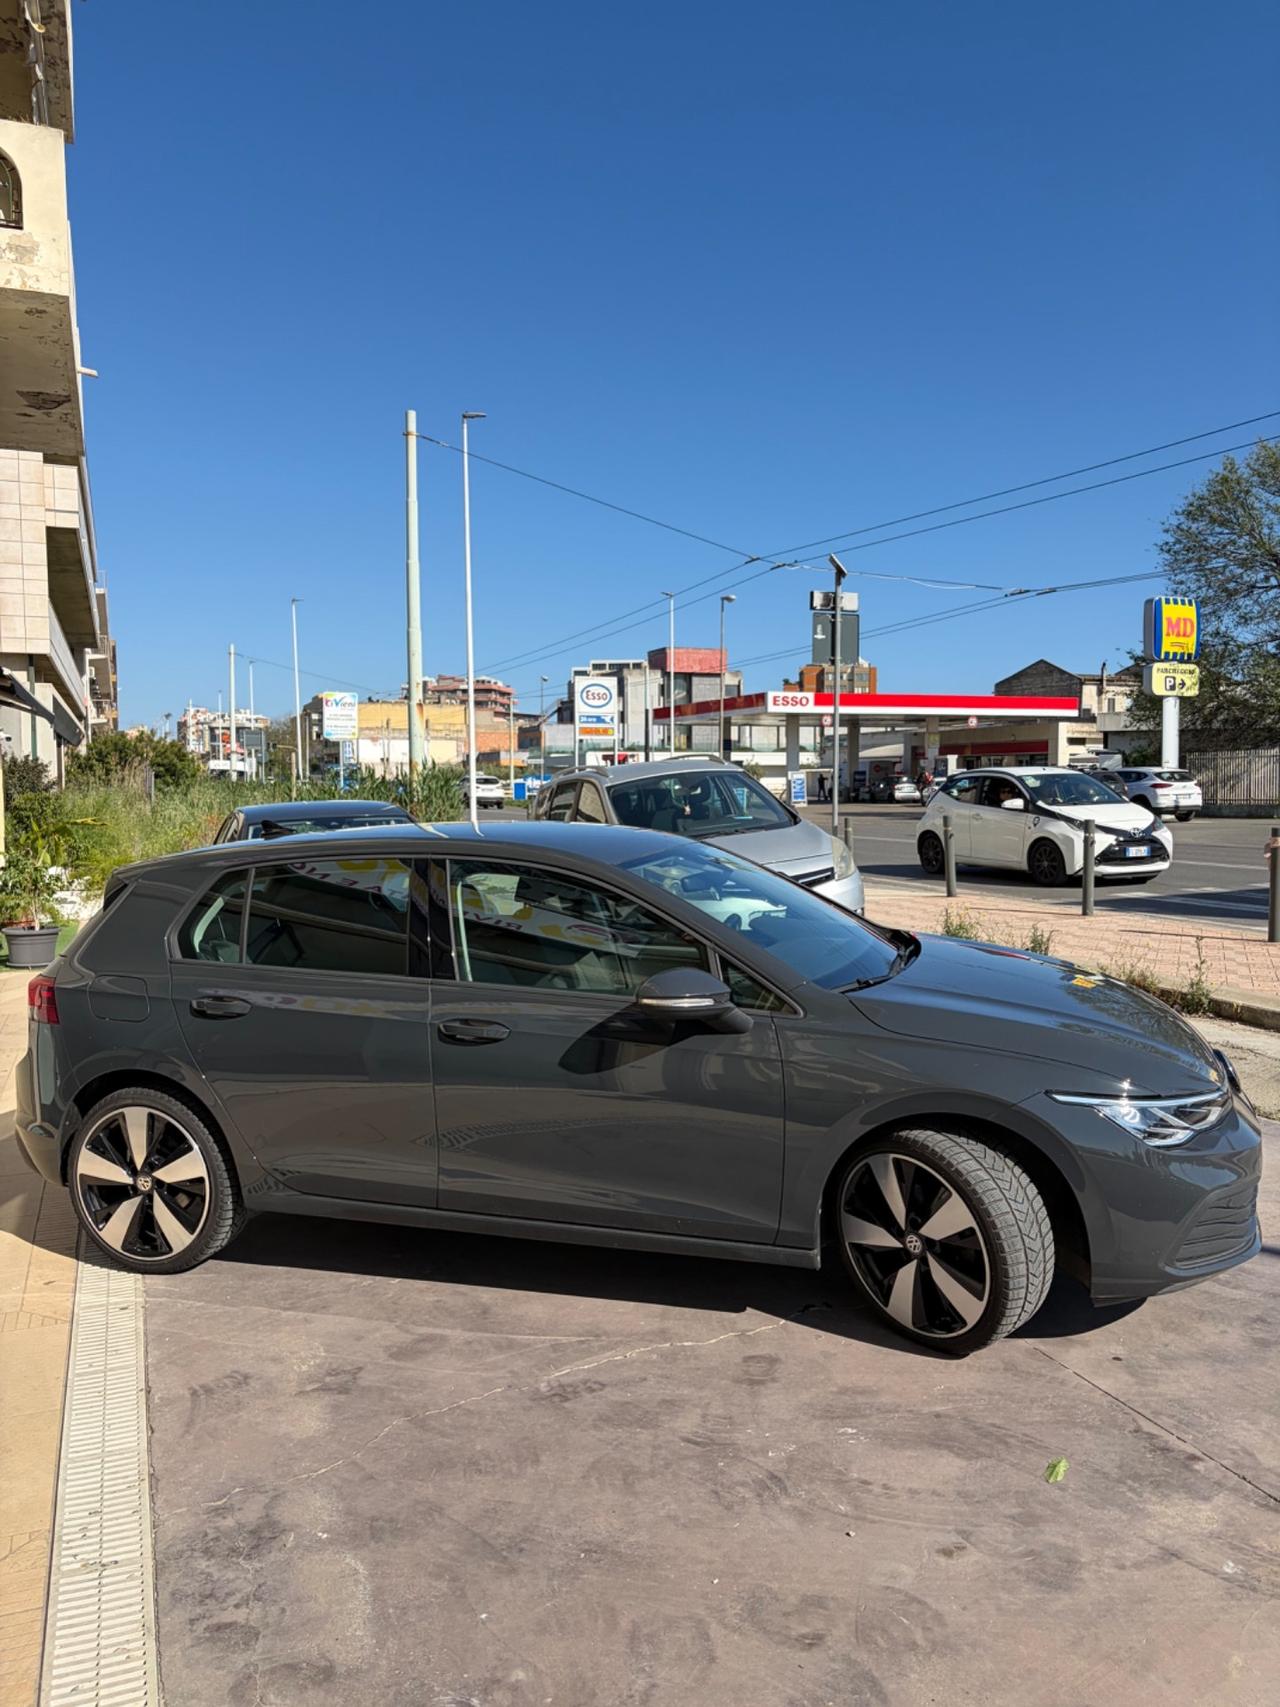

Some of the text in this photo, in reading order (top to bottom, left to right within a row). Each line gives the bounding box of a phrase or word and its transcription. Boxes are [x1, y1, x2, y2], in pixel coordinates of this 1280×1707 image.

[1166, 617, 1195, 638] MD
[585, 690, 608, 701] Esso
[773, 696, 810, 707] ESSO
